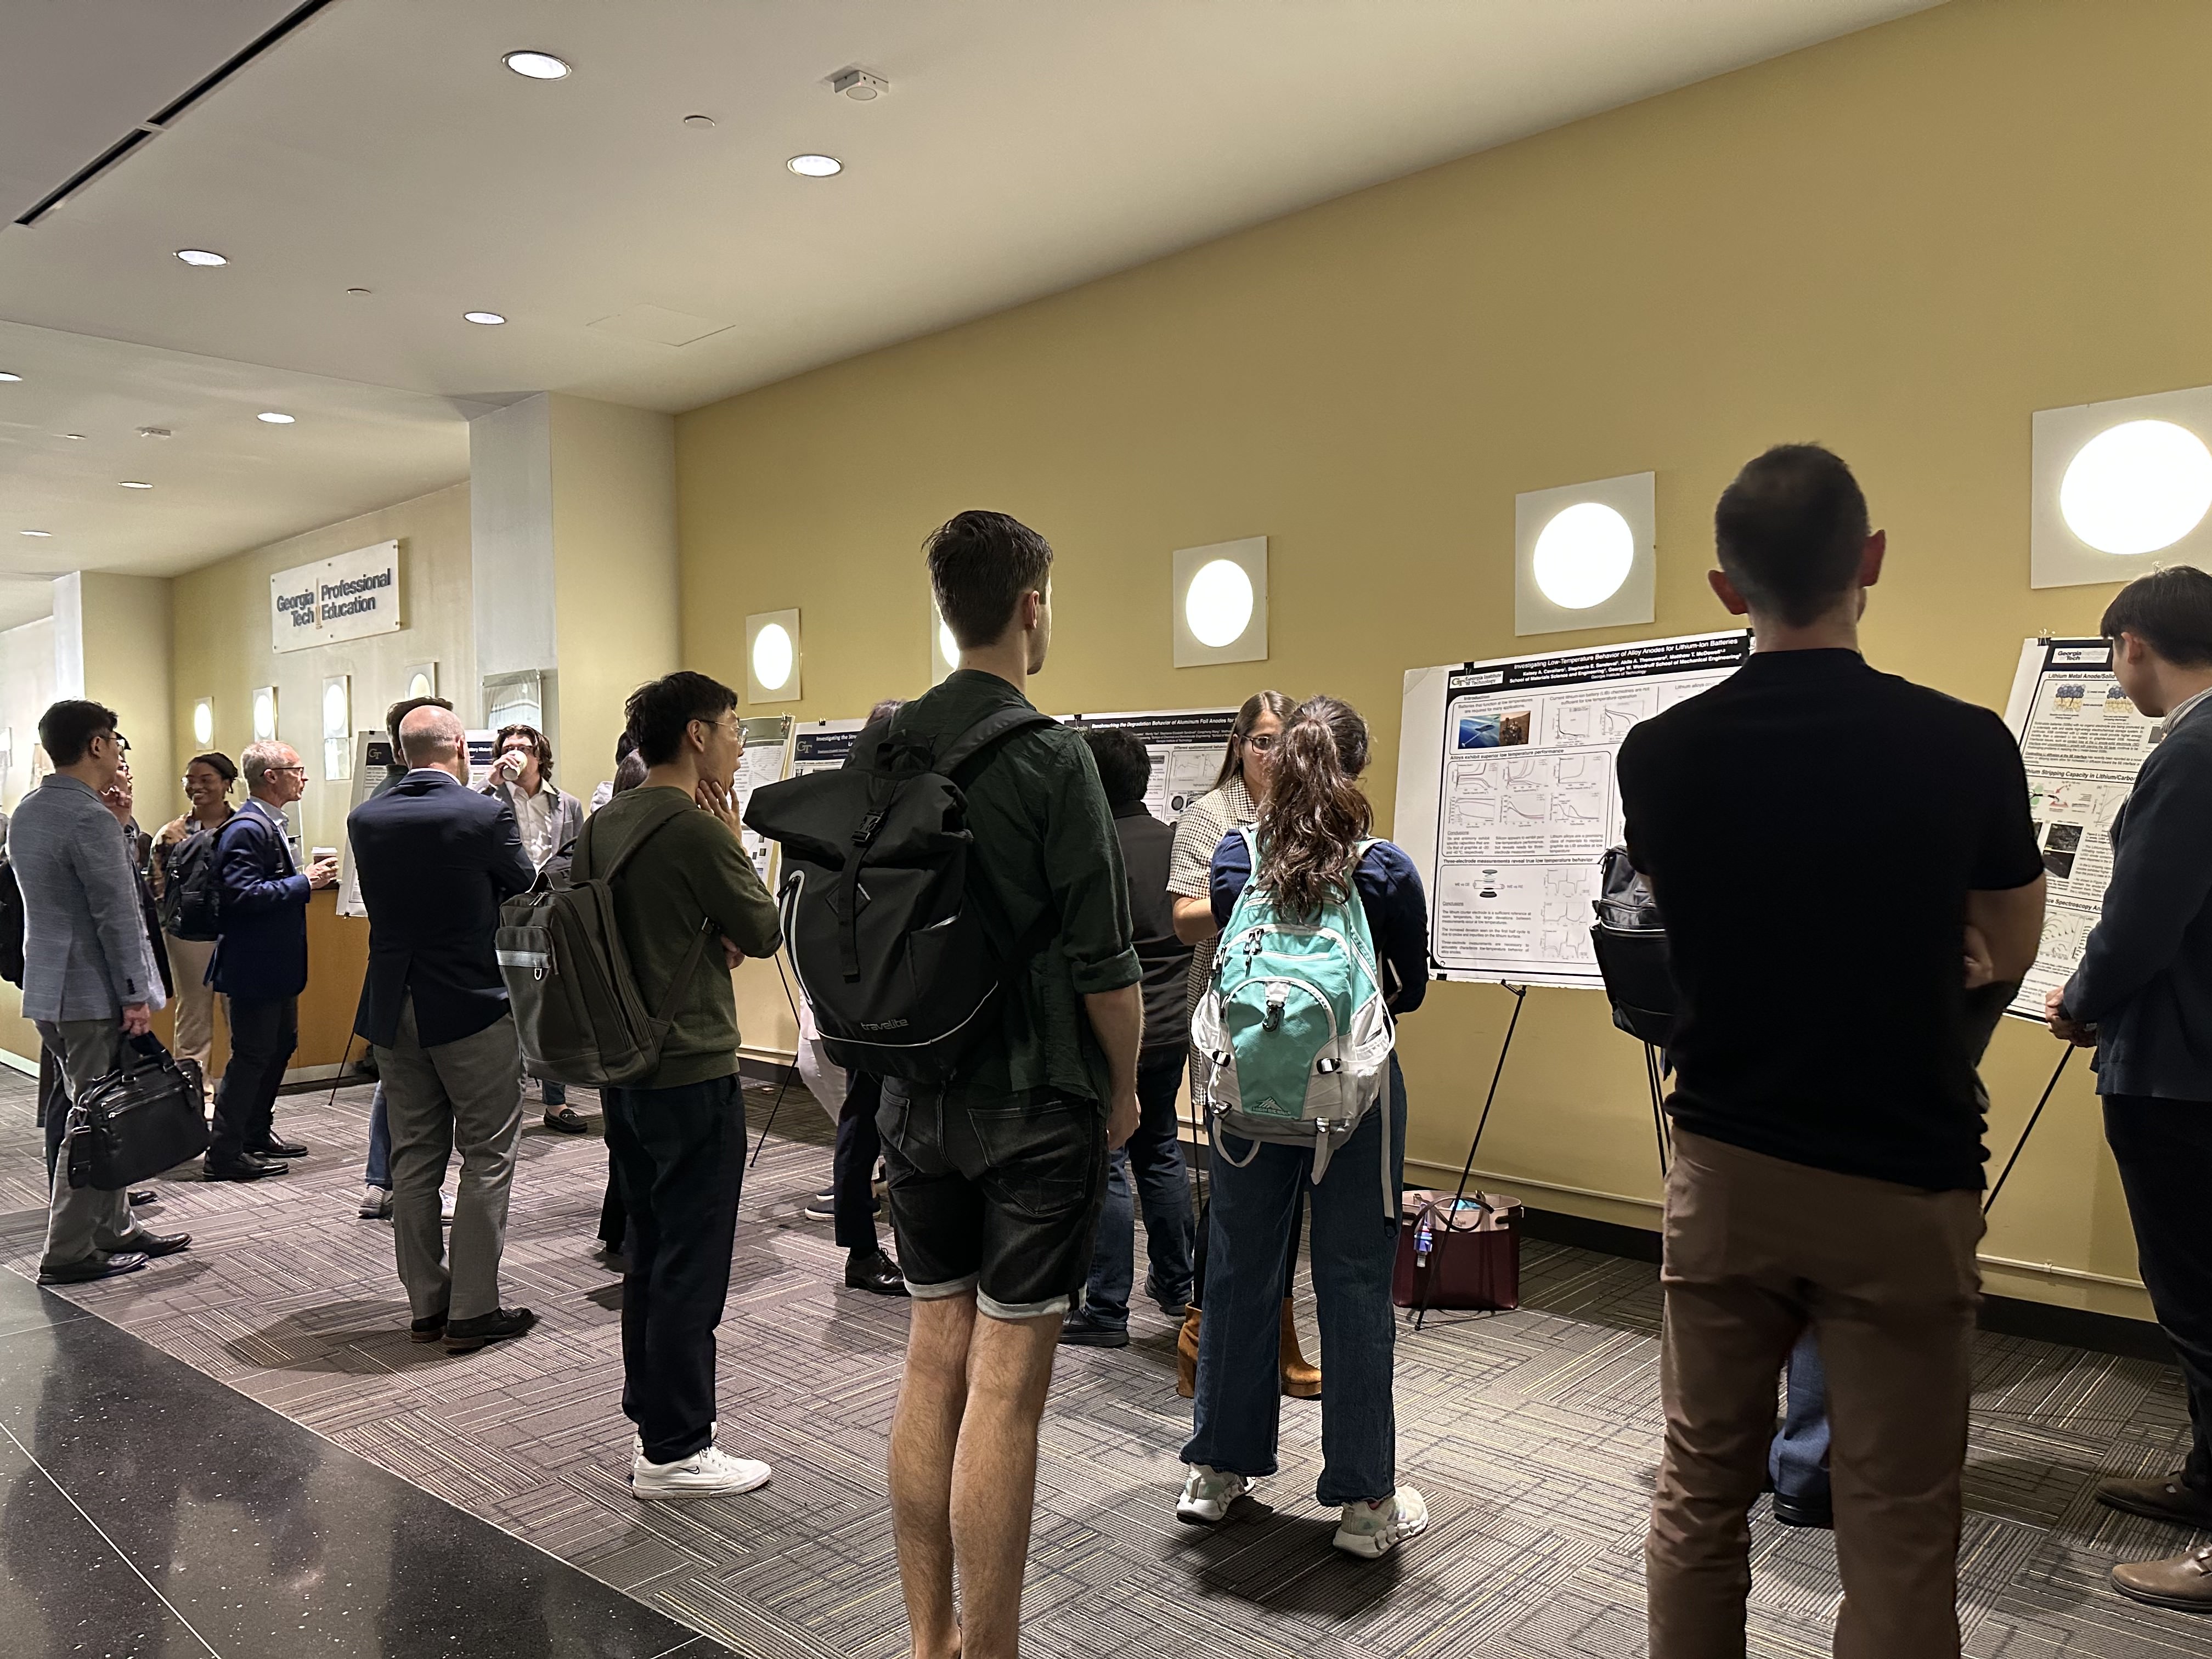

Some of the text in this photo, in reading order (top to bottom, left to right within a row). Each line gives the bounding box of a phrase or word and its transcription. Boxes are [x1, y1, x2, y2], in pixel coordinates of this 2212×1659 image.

[321, 568, 391, 601] Professional
[277, 589, 314, 612] Georgia
[321, 596, 375, 620] Education
[291, 607, 314, 627] Tech
[1514, 661, 1546, 669] Investigating
[1548, 656, 1594, 665] Low-Temperature
[1675, 642, 1709, 651] Lithium-Ion
[1710, 639, 1738, 647] Batteries
[368, 748, 382, 759] GT
[797, 741, 812, 753] GT
[2055, 899, 2092, 910] Spectroscopy
[860, 1019, 909, 1030] travelite
